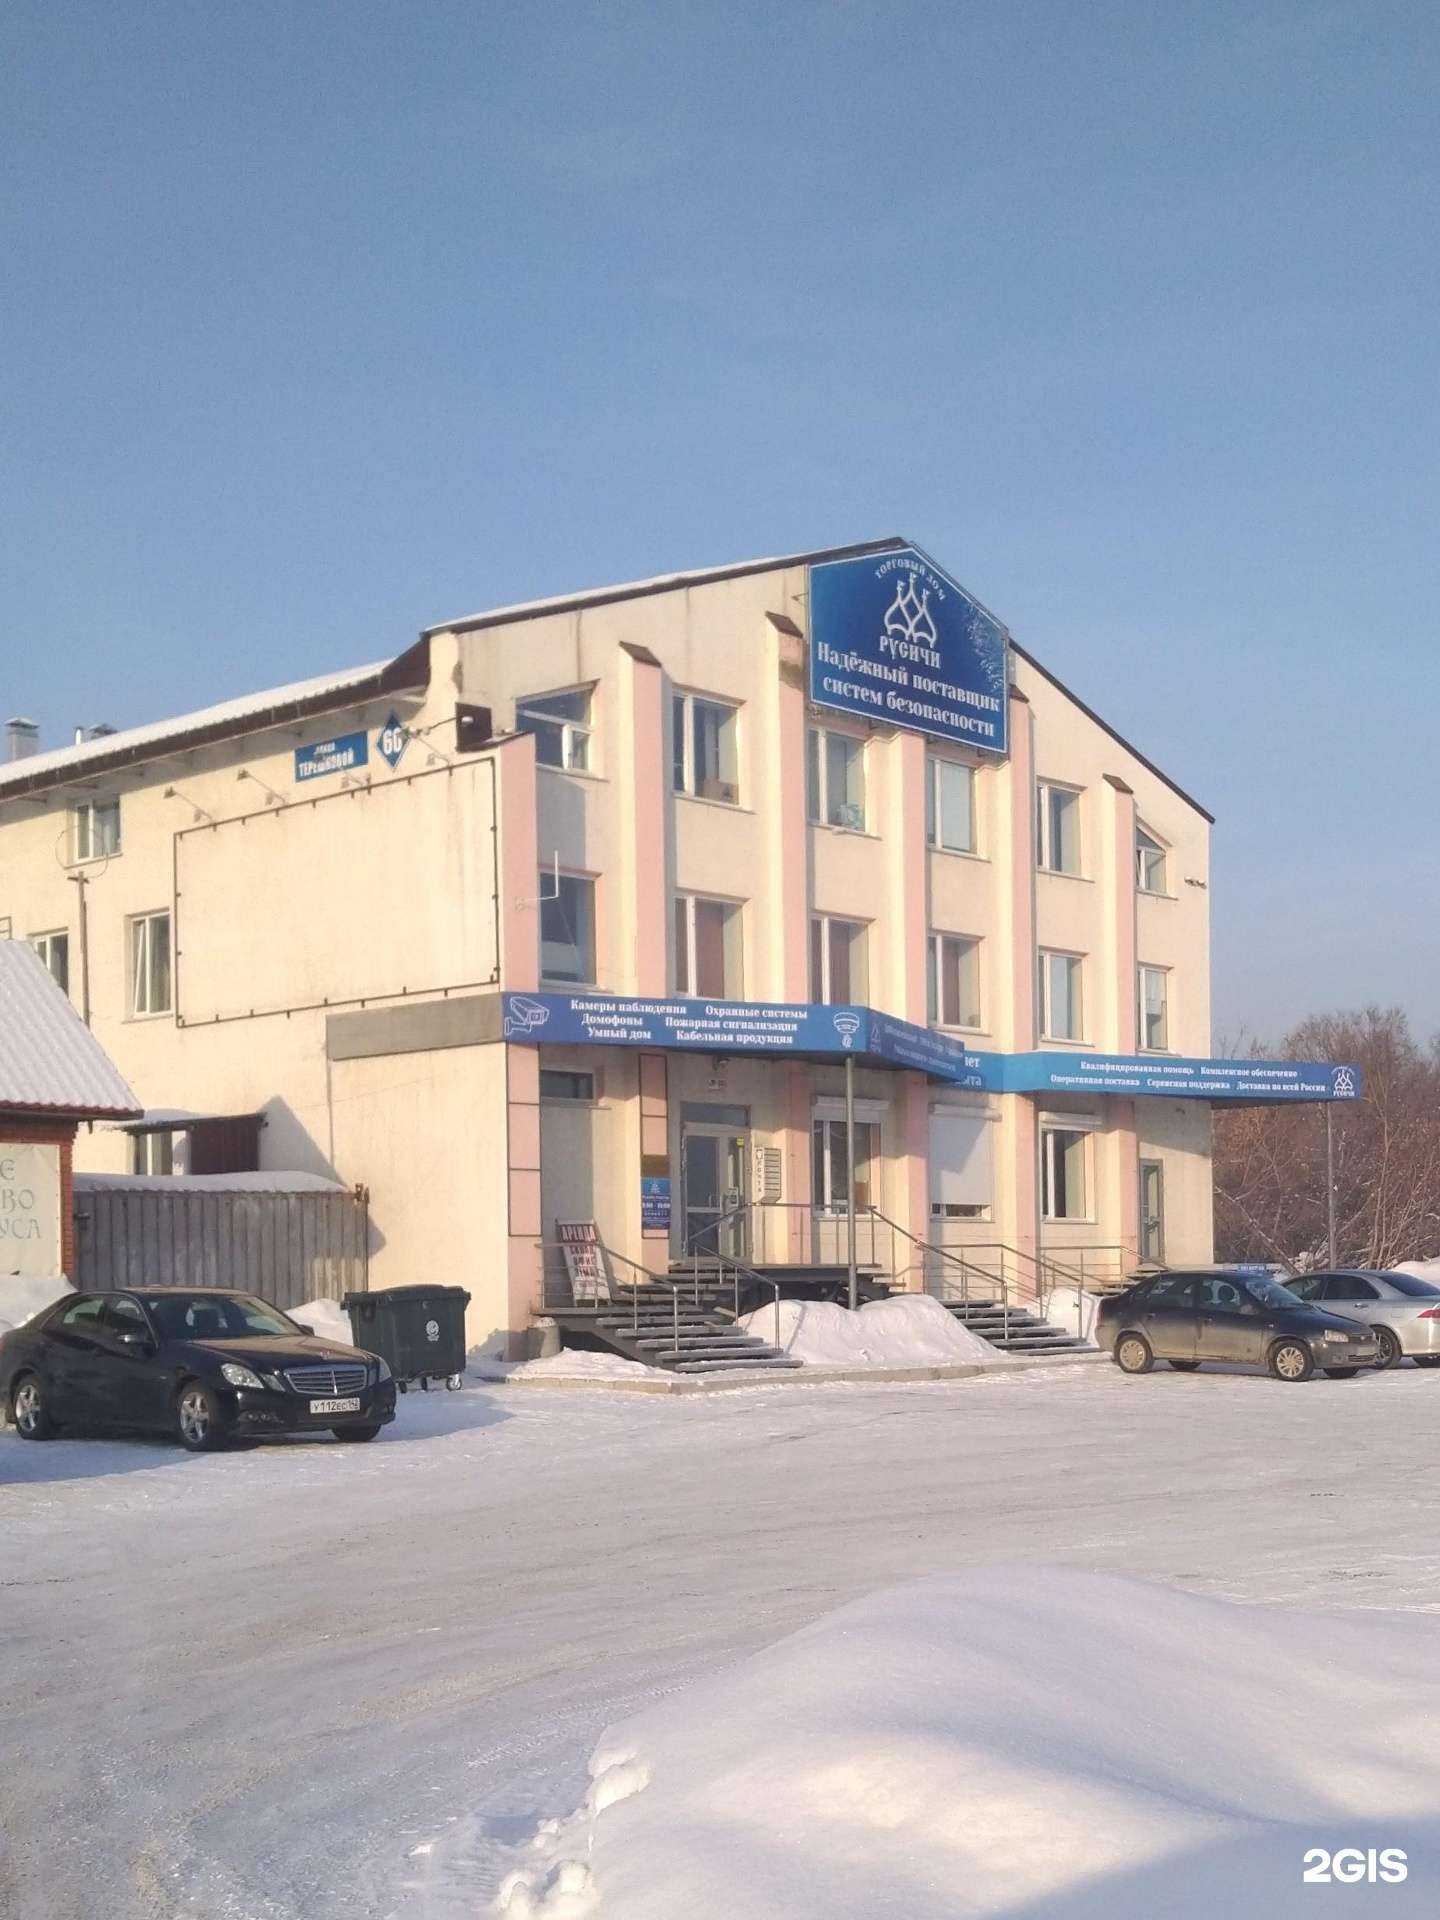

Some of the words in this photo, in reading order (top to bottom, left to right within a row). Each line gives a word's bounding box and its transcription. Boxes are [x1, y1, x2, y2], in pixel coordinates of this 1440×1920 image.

[879, 635, 941, 669] РУСИЧИ
[818, 641, 908, 686] Надёжный
[913, 674, 1000, 712] поставщик
[823, 677, 883, 706] систем
[886, 691, 994, 737] безопасности
[382, 727, 402, 755] 66
[571, 1000, 616, 1012] Камеры
[619, 1003, 687, 1015] наблюдения
[705, 1005, 760, 1018] Охранные
[762, 1009, 808, 1019] системы
[582, 1013, 643, 1026] Домофоны
[665, 1017, 720, 1029] Пожарная
[723, 1021, 798, 1032] сигнализация
[588, 1027, 627, 1038] Умный
[630, 1030, 651, 1040] дом
[676, 1030, 733, 1042] Кабельная
[736, 1034, 793, 1045] продукция
[1163, 1066, 1195, 1076] помощь
[562, 1225, 597, 1242] АРЕНДА
